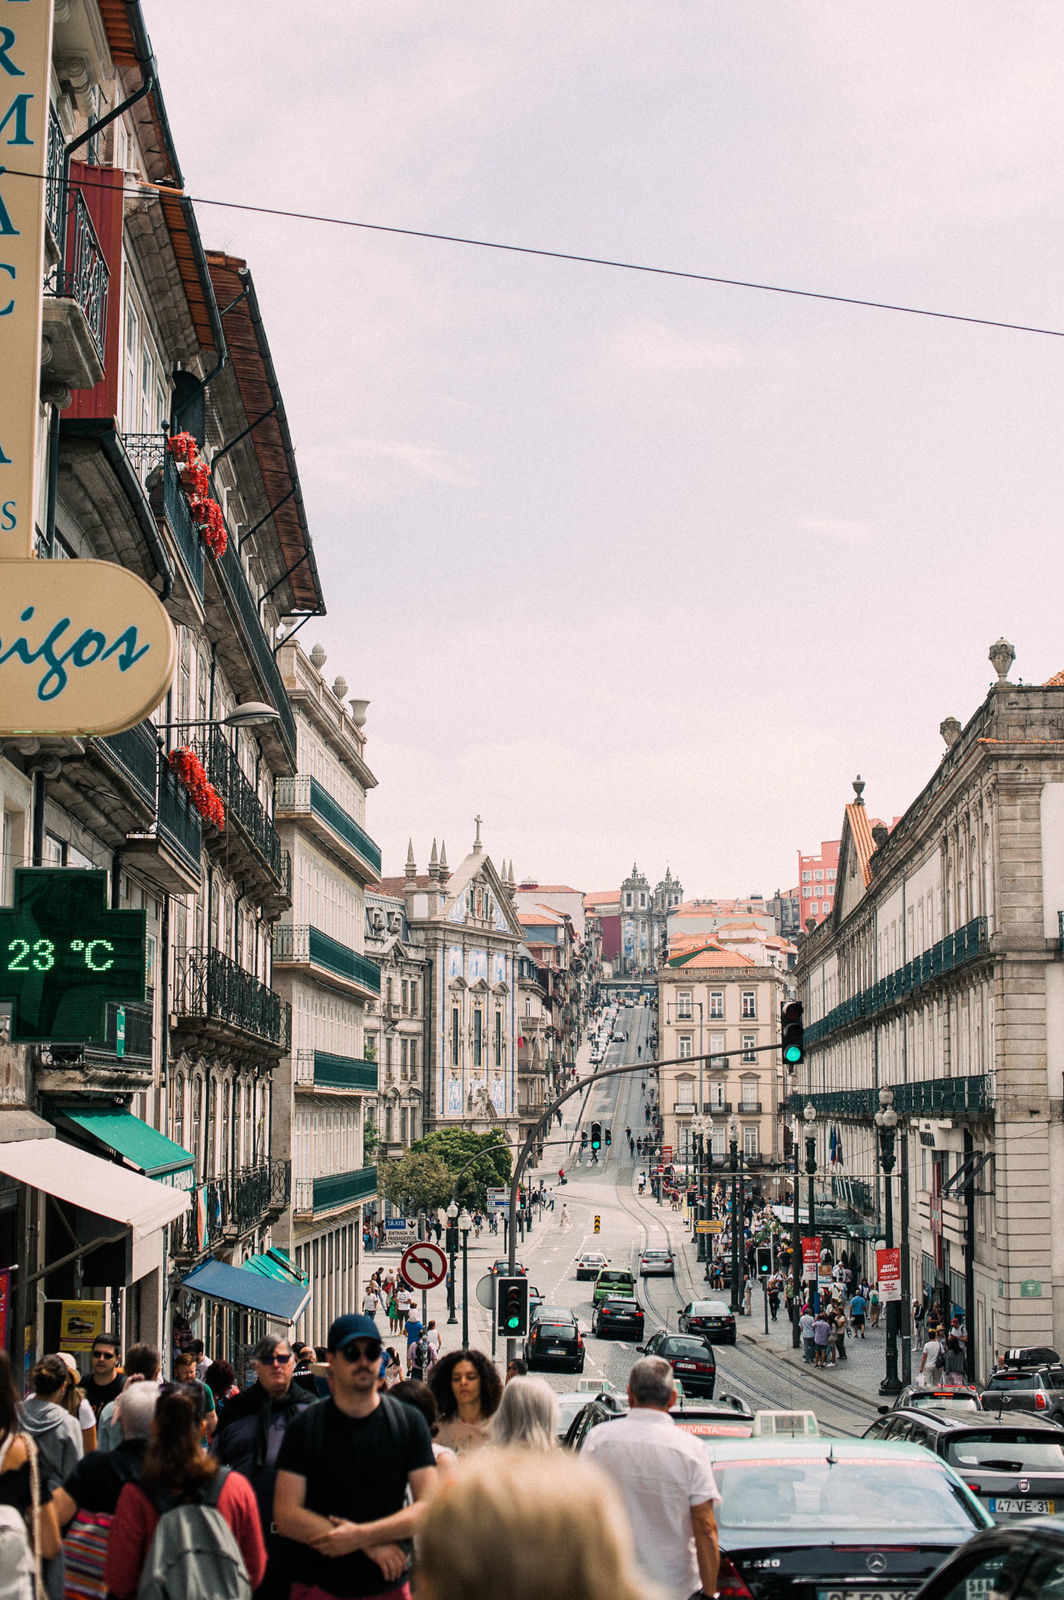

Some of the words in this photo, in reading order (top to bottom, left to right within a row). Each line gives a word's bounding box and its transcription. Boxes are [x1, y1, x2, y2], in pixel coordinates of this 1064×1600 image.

[0, 606, 151, 701] igos
[7, 939, 55, 971] 23
[70, 939, 114, 971] °C
[680, 1424, 720, 1434] INVICTA
